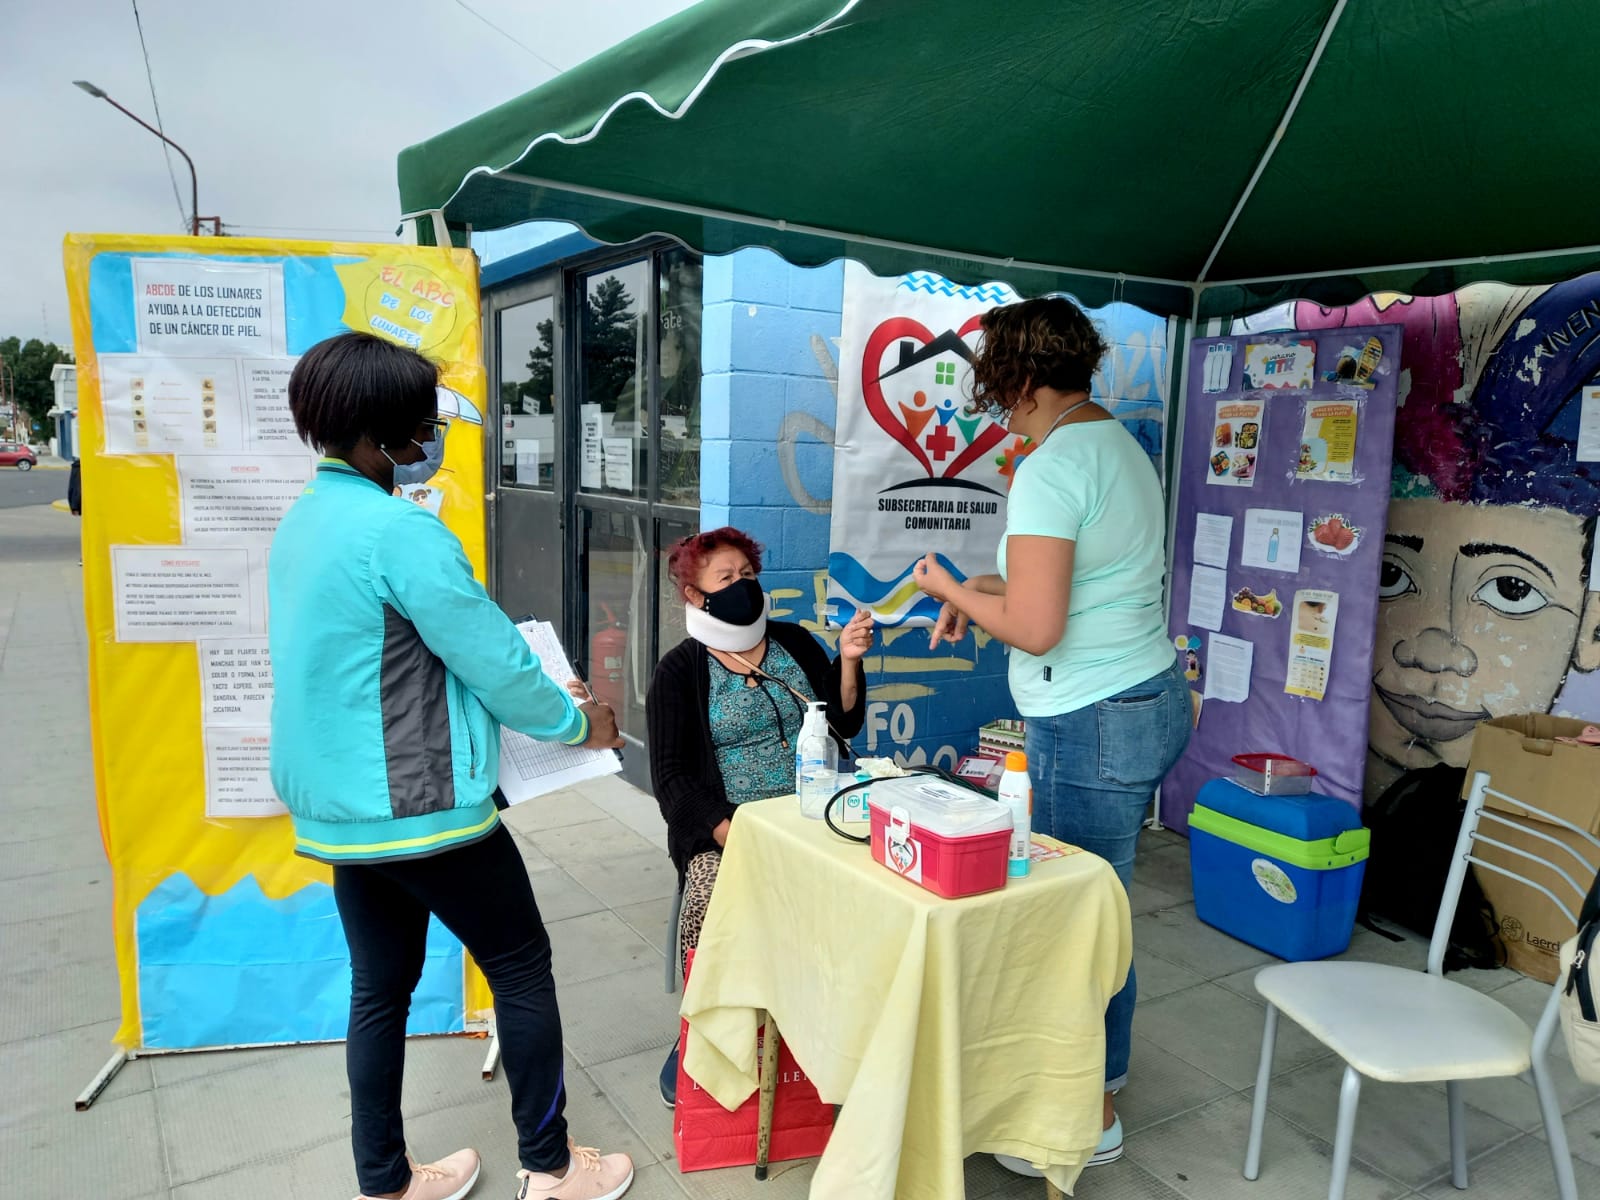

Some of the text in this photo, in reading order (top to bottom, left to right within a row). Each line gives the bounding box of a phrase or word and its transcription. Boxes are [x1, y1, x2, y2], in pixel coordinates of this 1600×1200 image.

[146, 283, 262, 300] ABCDE DE LOS LUNARES
[382, 266, 454, 306] EL ABC
[148, 303, 262, 318] AYUDA A LA DETECCIÓN
[380, 293, 433, 323] DE LOS
[660, 311, 682, 329] ate
[150, 321, 262, 337] DE UN CÁNCER DE PIEL.
[371, 317, 422, 348] LUNARES
[878, 498, 997, 514] SUBSECRETARIA DE SALUD
[905, 516, 971, 530] COMUNITARIA
[867, 702, 915, 751] FO
